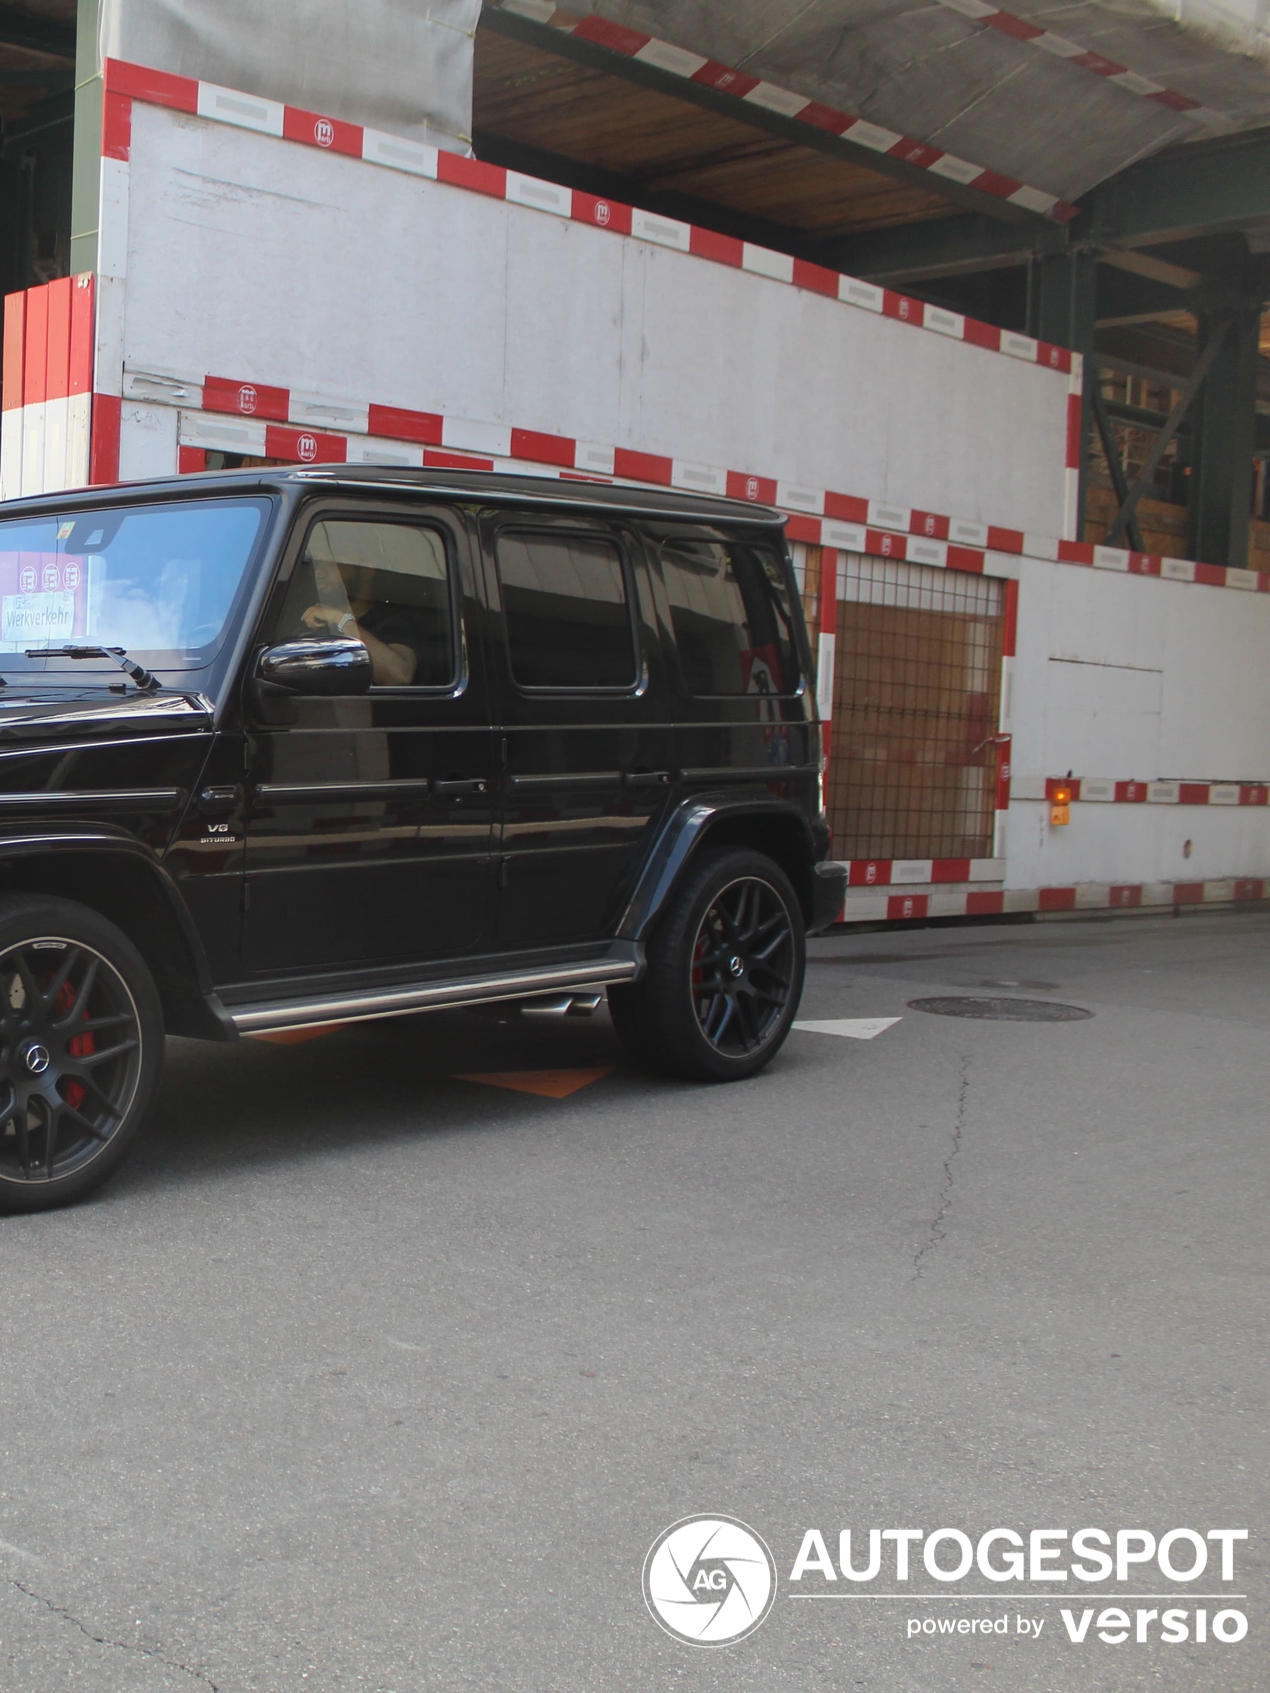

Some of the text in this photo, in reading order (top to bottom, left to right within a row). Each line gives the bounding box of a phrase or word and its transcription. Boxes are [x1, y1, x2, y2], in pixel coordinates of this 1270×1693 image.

[7, 606, 70, 627] Werkverkehr
[207, 823, 229, 833] V8
[200, 836, 236, 844] BITURBO
